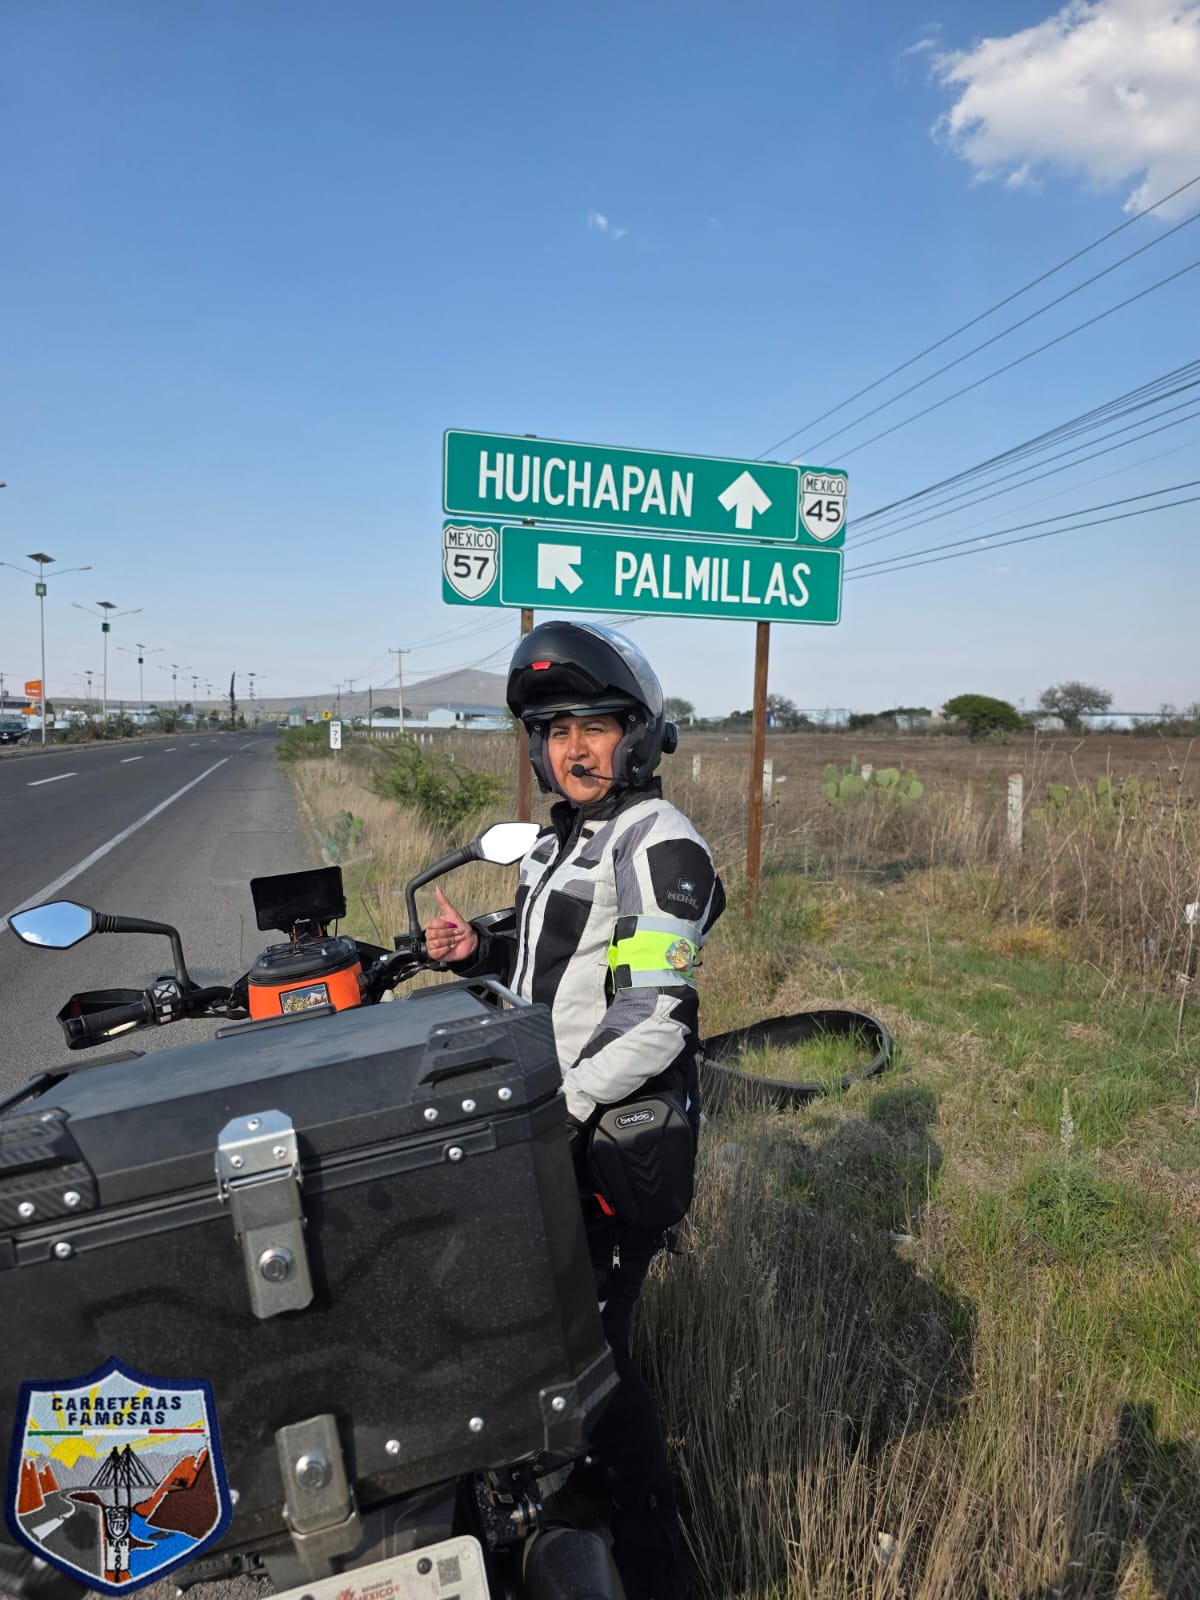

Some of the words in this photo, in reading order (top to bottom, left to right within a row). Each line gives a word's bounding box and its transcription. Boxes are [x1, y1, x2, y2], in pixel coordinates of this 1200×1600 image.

[478, 451, 694, 517] HUICHAPAN
[805, 478, 844, 494] MEXICO
[806, 500, 841, 523] 45
[448, 532, 493, 548] MEXICO
[454, 554, 489, 580] 57
[615, 551, 811, 607] PALMILLAS
